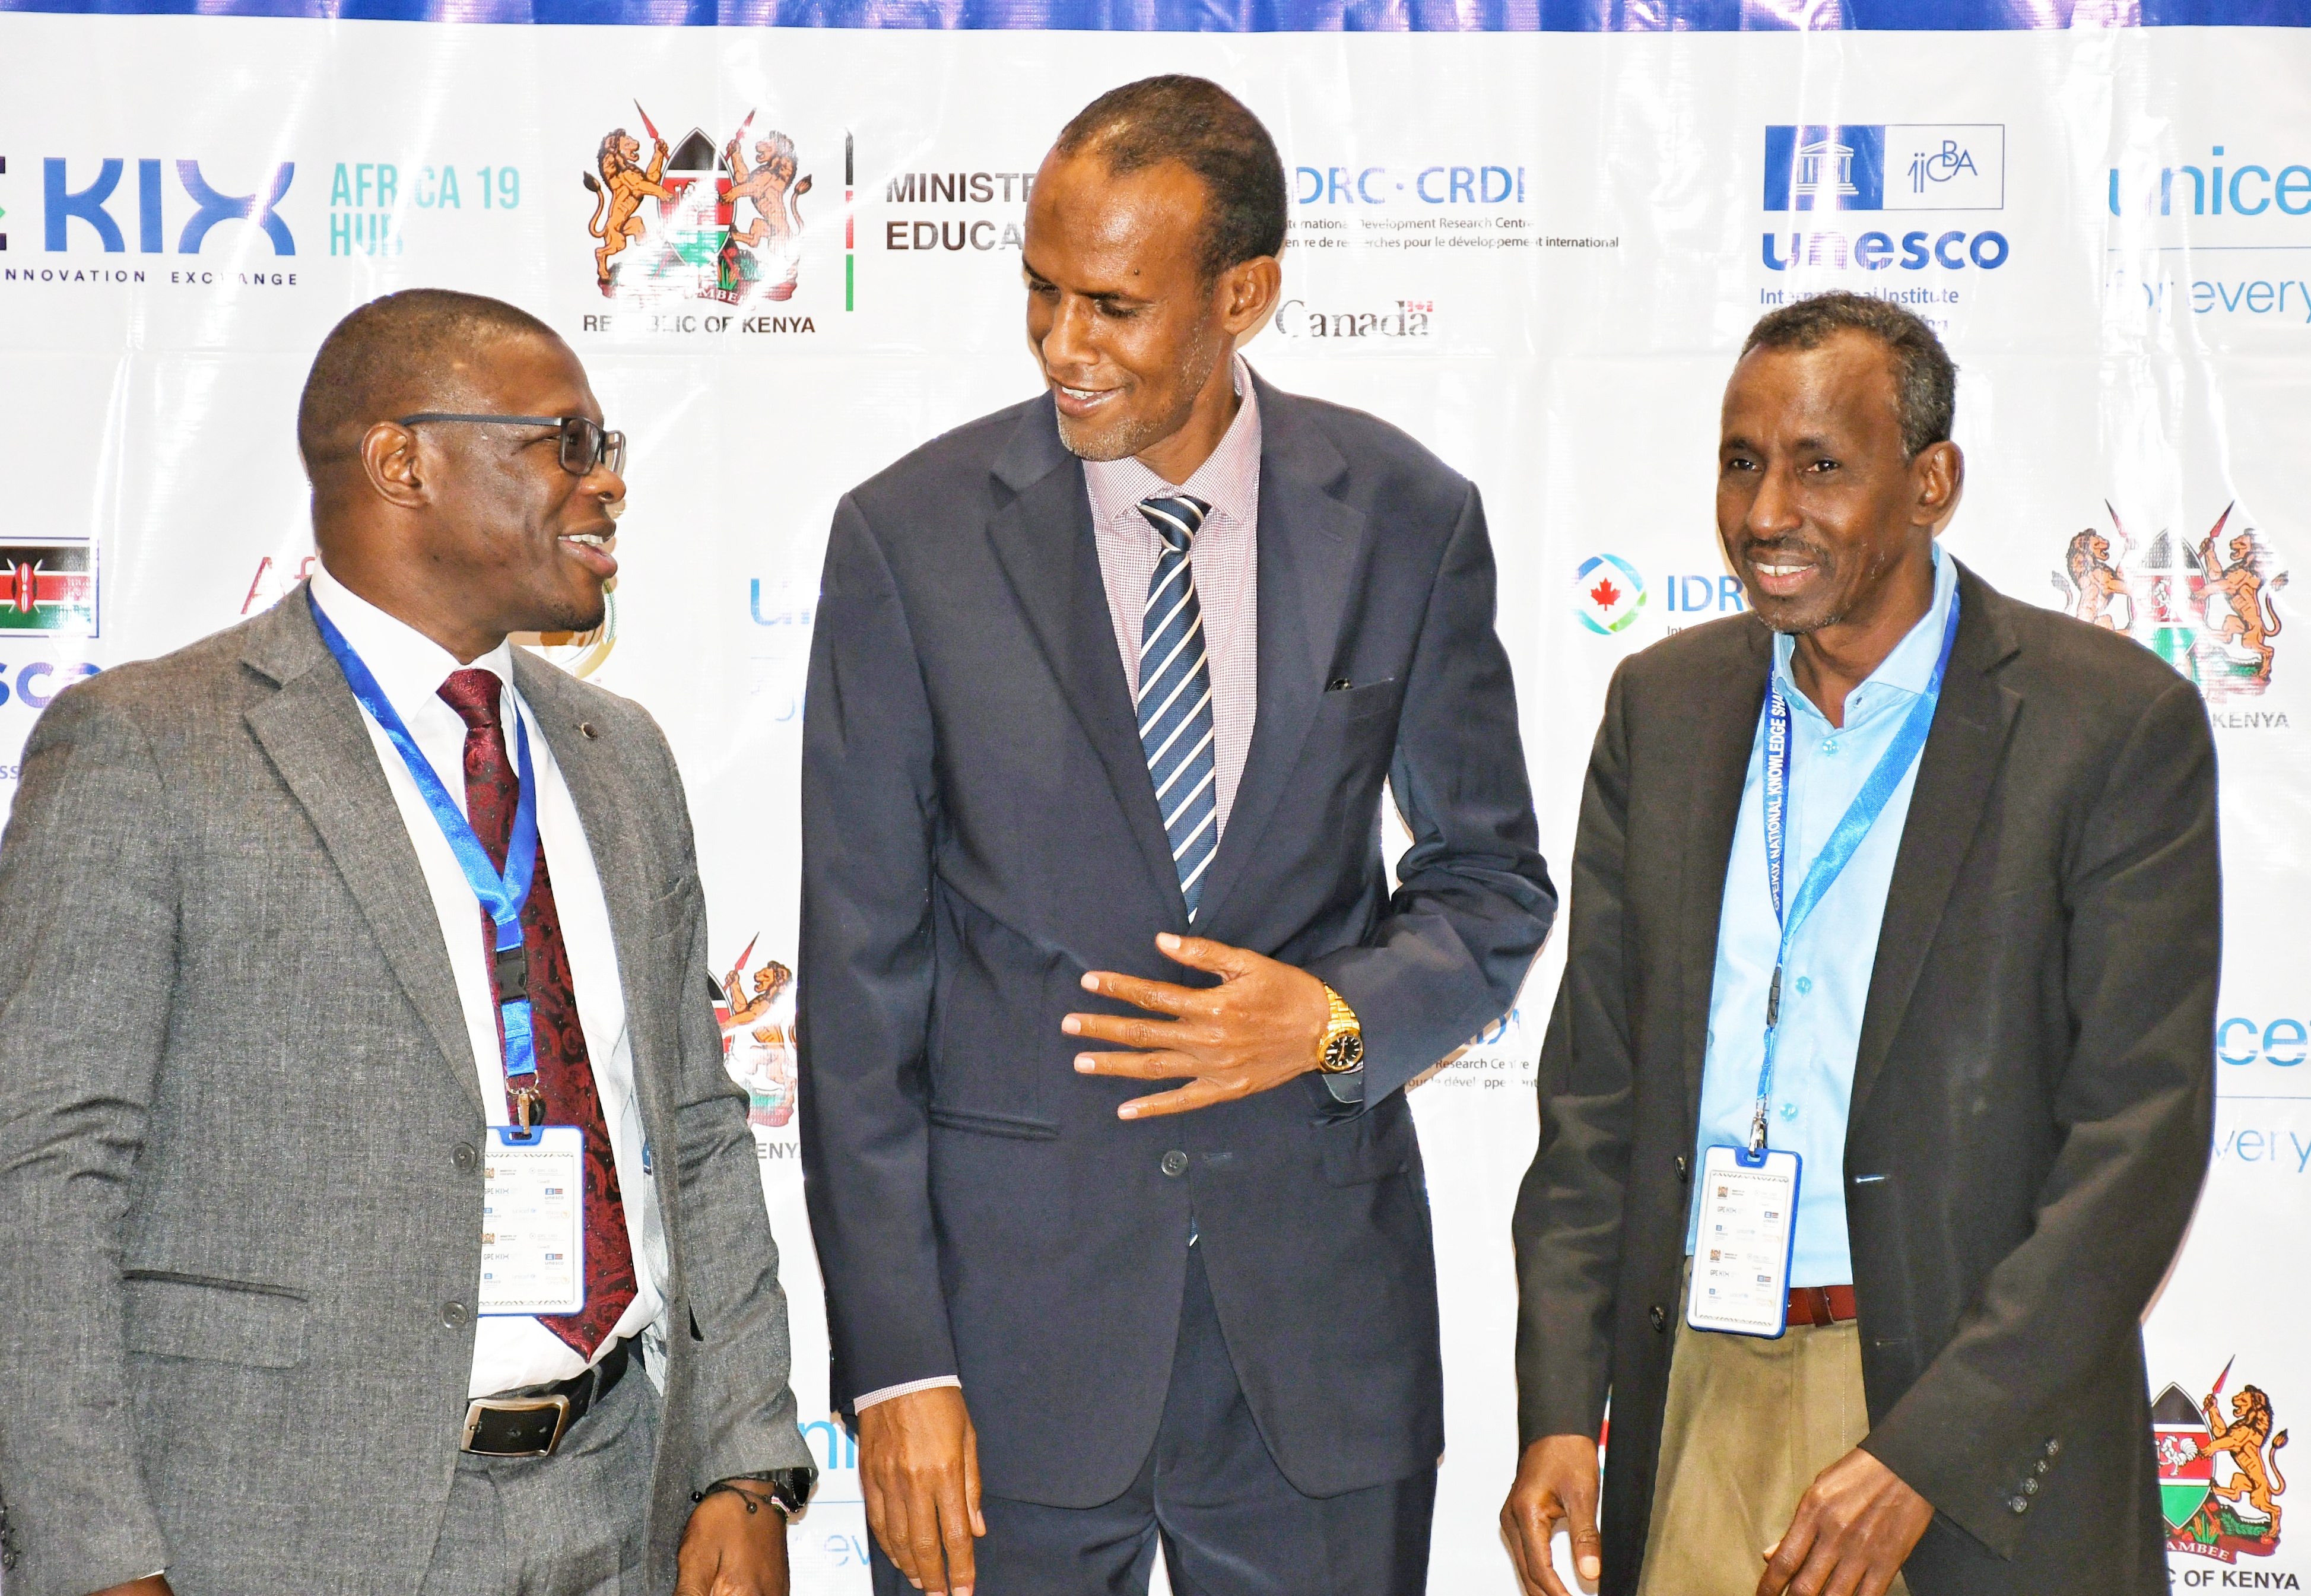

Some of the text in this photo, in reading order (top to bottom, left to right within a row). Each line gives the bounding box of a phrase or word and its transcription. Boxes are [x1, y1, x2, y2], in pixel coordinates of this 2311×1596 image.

[331, 163, 520, 209] AFRCA 19
[1417, 166, 1525, 204] CRDI
[44, 157, 296, 256] KIX
[1319, 236, 1334, 248] de
[1404, 238, 1431, 249] pour
[1435, 236, 1446, 247] le
[1545, 236, 1619, 248] international
[1762, 231, 2009, 271] unesco
[172, 272, 297, 285] EXCANGE
[742, 316, 816, 334] KENYA
[2212, 712, 2290, 729] KENYA
[1767, 718, 1786, 796] KNOWLEDGE
[1767, 796, 1782, 859] NATIONAL
[2184, 1570, 2215, 1587] OF
[2222, 1570, 2301, 1591] KENYA
